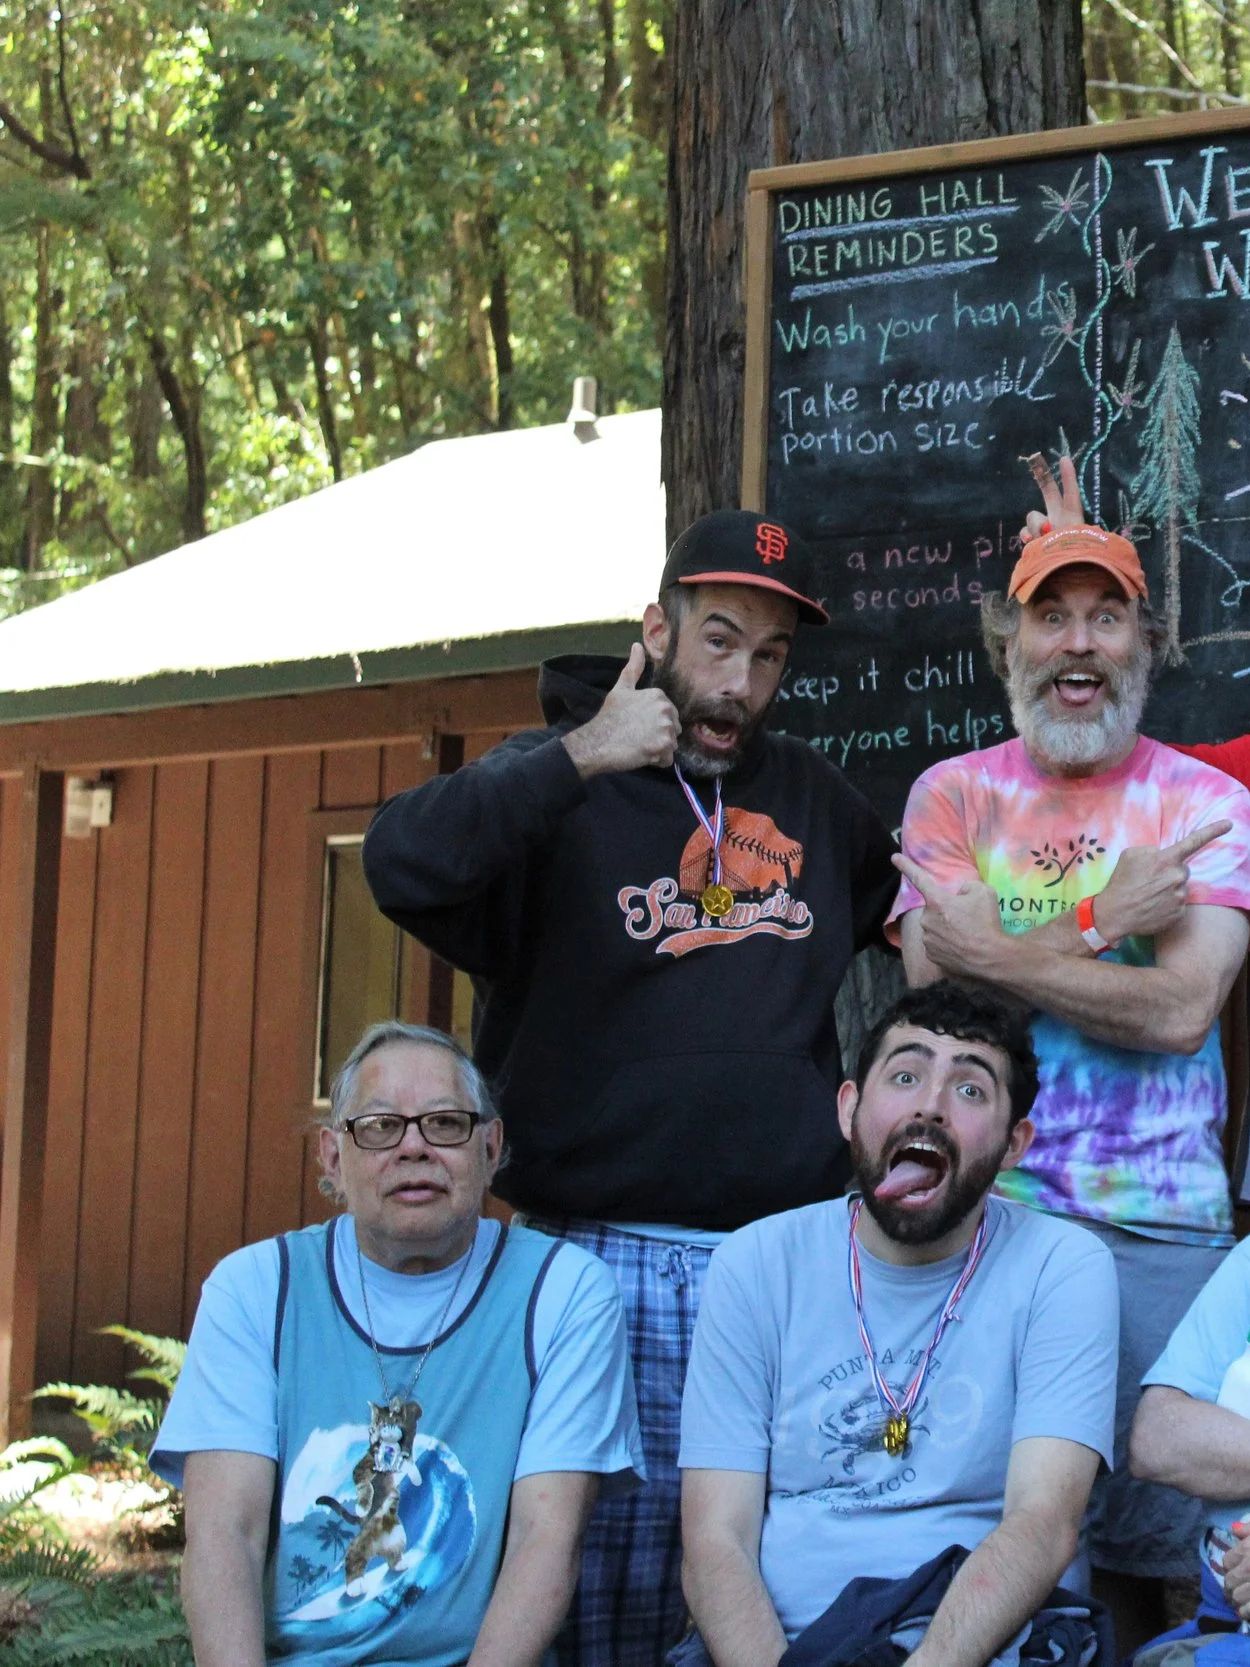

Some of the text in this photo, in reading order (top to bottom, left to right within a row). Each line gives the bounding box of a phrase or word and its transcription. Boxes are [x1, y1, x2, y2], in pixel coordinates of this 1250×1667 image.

[777, 174, 1017, 234] DINING HALL
[788, 223, 998, 277] REMINDERS
[776, 273, 1069, 365] Wash your hands
[779, 382, 859, 428] Take
[781, 424, 898, 466] portion
[846, 549, 867, 573] a
[884, 540, 954, 570] new
[973, 519, 1024, 570] pla
[853, 573, 984, 612] seconds
[858, 657, 880, 692] it
[904, 650, 974, 693] chill
[926, 709, 1004, 750] helps
[617, 877, 698, 940] San
